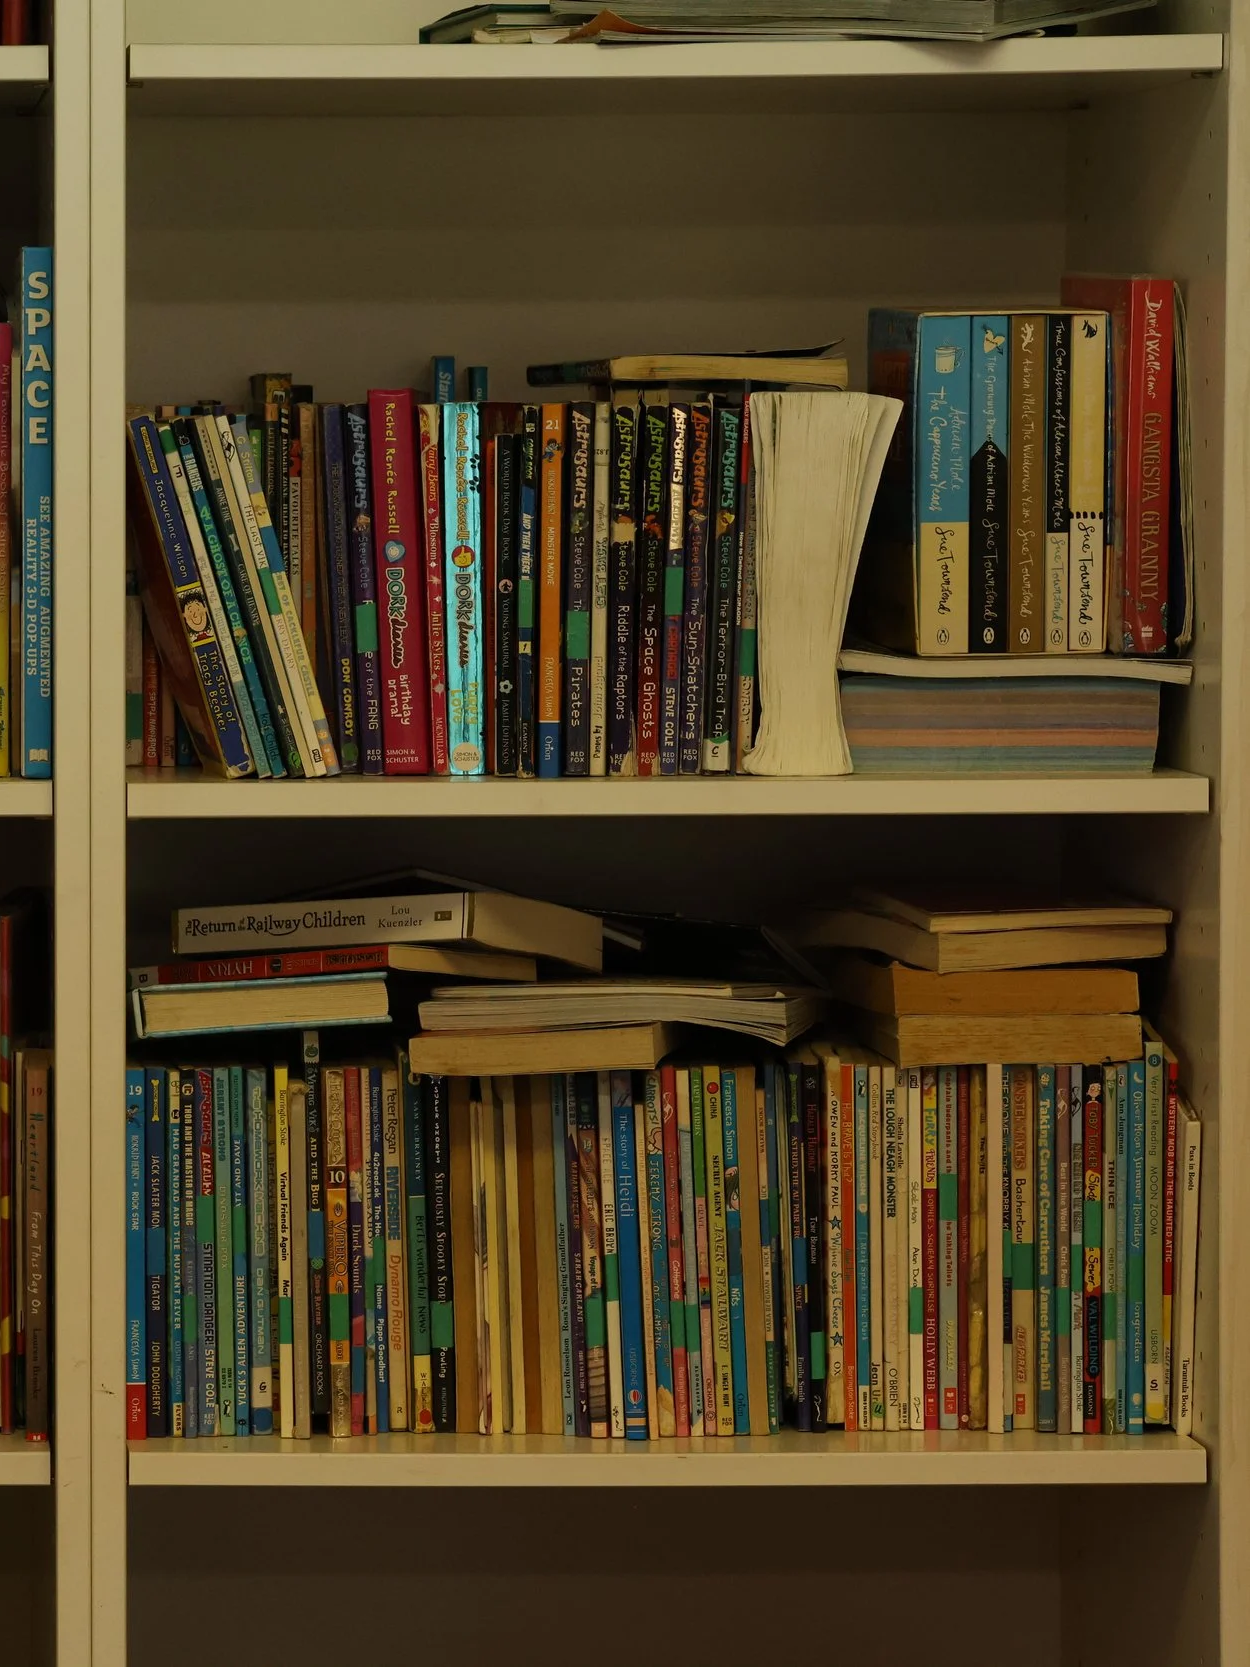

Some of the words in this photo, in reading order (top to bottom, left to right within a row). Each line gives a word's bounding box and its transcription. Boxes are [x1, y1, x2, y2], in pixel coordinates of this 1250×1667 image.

[25, 270, 50, 445] SPACE
[930, 386, 947, 413] The
[385, 403, 398, 442] Rachel
[927, 416, 946, 481] Cappuccino
[1140, 411, 1162, 504] GANGSTA
[385, 447, 397, 485] Renée
[38, 495, 51, 524] SEE
[386, 490, 400, 534] Russell
[929, 480, 946, 512] Years
[153, 478, 178, 539] Jacqueline
[174, 542, 189, 579] Wilson
[935, 526, 953, 554] Sue
[25, 517, 38, 583] REALITY
[38, 526, 51, 597] AMAZING
[1140, 510, 1161, 602] GRANNY
[26, 586, 37, 609] 3-D
[936, 553, 953, 615] Townsend
[615, 605, 629, 643] Riddle
[646, 604, 655, 622] The
[719, 598, 729, 618] The
[25, 613, 38, 676] POP-UPS
[38, 606, 51, 698] AUGMENTED
[208, 649, 219, 669] The
[617, 645, 626, 655] of
[643, 627, 655, 676] Space
[617, 656, 627, 672] the
[685, 620, 700, 740] Sun-Snatchers
[715, 621, 729, 705] Terror-Bird
[197, 652, 213, 687] Tracy
[205, 689, 227, 732] Beaker
[211, 671, 226, 707] Story
[387, 678, 401, 718] Drama!
[395, 674, 413, 725] Birthday
[570, 667, 583, 727] Pirates
[614, 674, 626, 720] Raptors
[226, 711, 236, 723] of
[642, 682, 655, 739] Ghosts
[713, 708, 726, 738] Trap
[543, 736, 554, 761] Orion
[191, 915, 237, 937] Return
[246, 911, 301, 937] Railway
[302, 910, 366, 932] Children
[377, 915, 424, 929] Kuenzler
[390, 905, 411, 916] Lou
[885, 1088, 895, 1104] THE
[619, 1113, 630, 1134] The
[885, 1106, 895, 1138] LOUGH
[618, 1136, 630, 1159] story
[885, 1140, 896, 1174] NEAGH
[621, 1160, 631, 1171] of
[711, 1154, 720, 1191] SECRET
[1107, 1159, 1115, 1184] THIN
[1148, 1166, 1158, 1199] MOON
[279, 1171, 288, 1200] Virtual
[433, 1172, 447, 1229] SERIOUSLY
[619, 1174, 635, 1218] Heidi
[885, 1176, 897, 1218] MONSTER
[1107, 1186, 1115, 1210] ICE
[279, 1202, 288, 1234] Friends
[712, 1193, 721, 1218] AGENT
[1148, 1203, 1158, 1236] ZOOM
[279, 1235, 289, 1261] Again
[351, 1224, 362, 1250] Duck
[434, 1231, 448, 1273] SPOOKY
[351, 1252, 362, 1294] Sounds
[151, 1341, 161, 1363] JOHN
[925, 1317, 936, 1355] HOLLY
[151, 1366, 161, 1416] DOUGHERTY
[926, 1358, 936, 1390] WEBB
[1180, 1358, 1190, 1392] Tarantula
